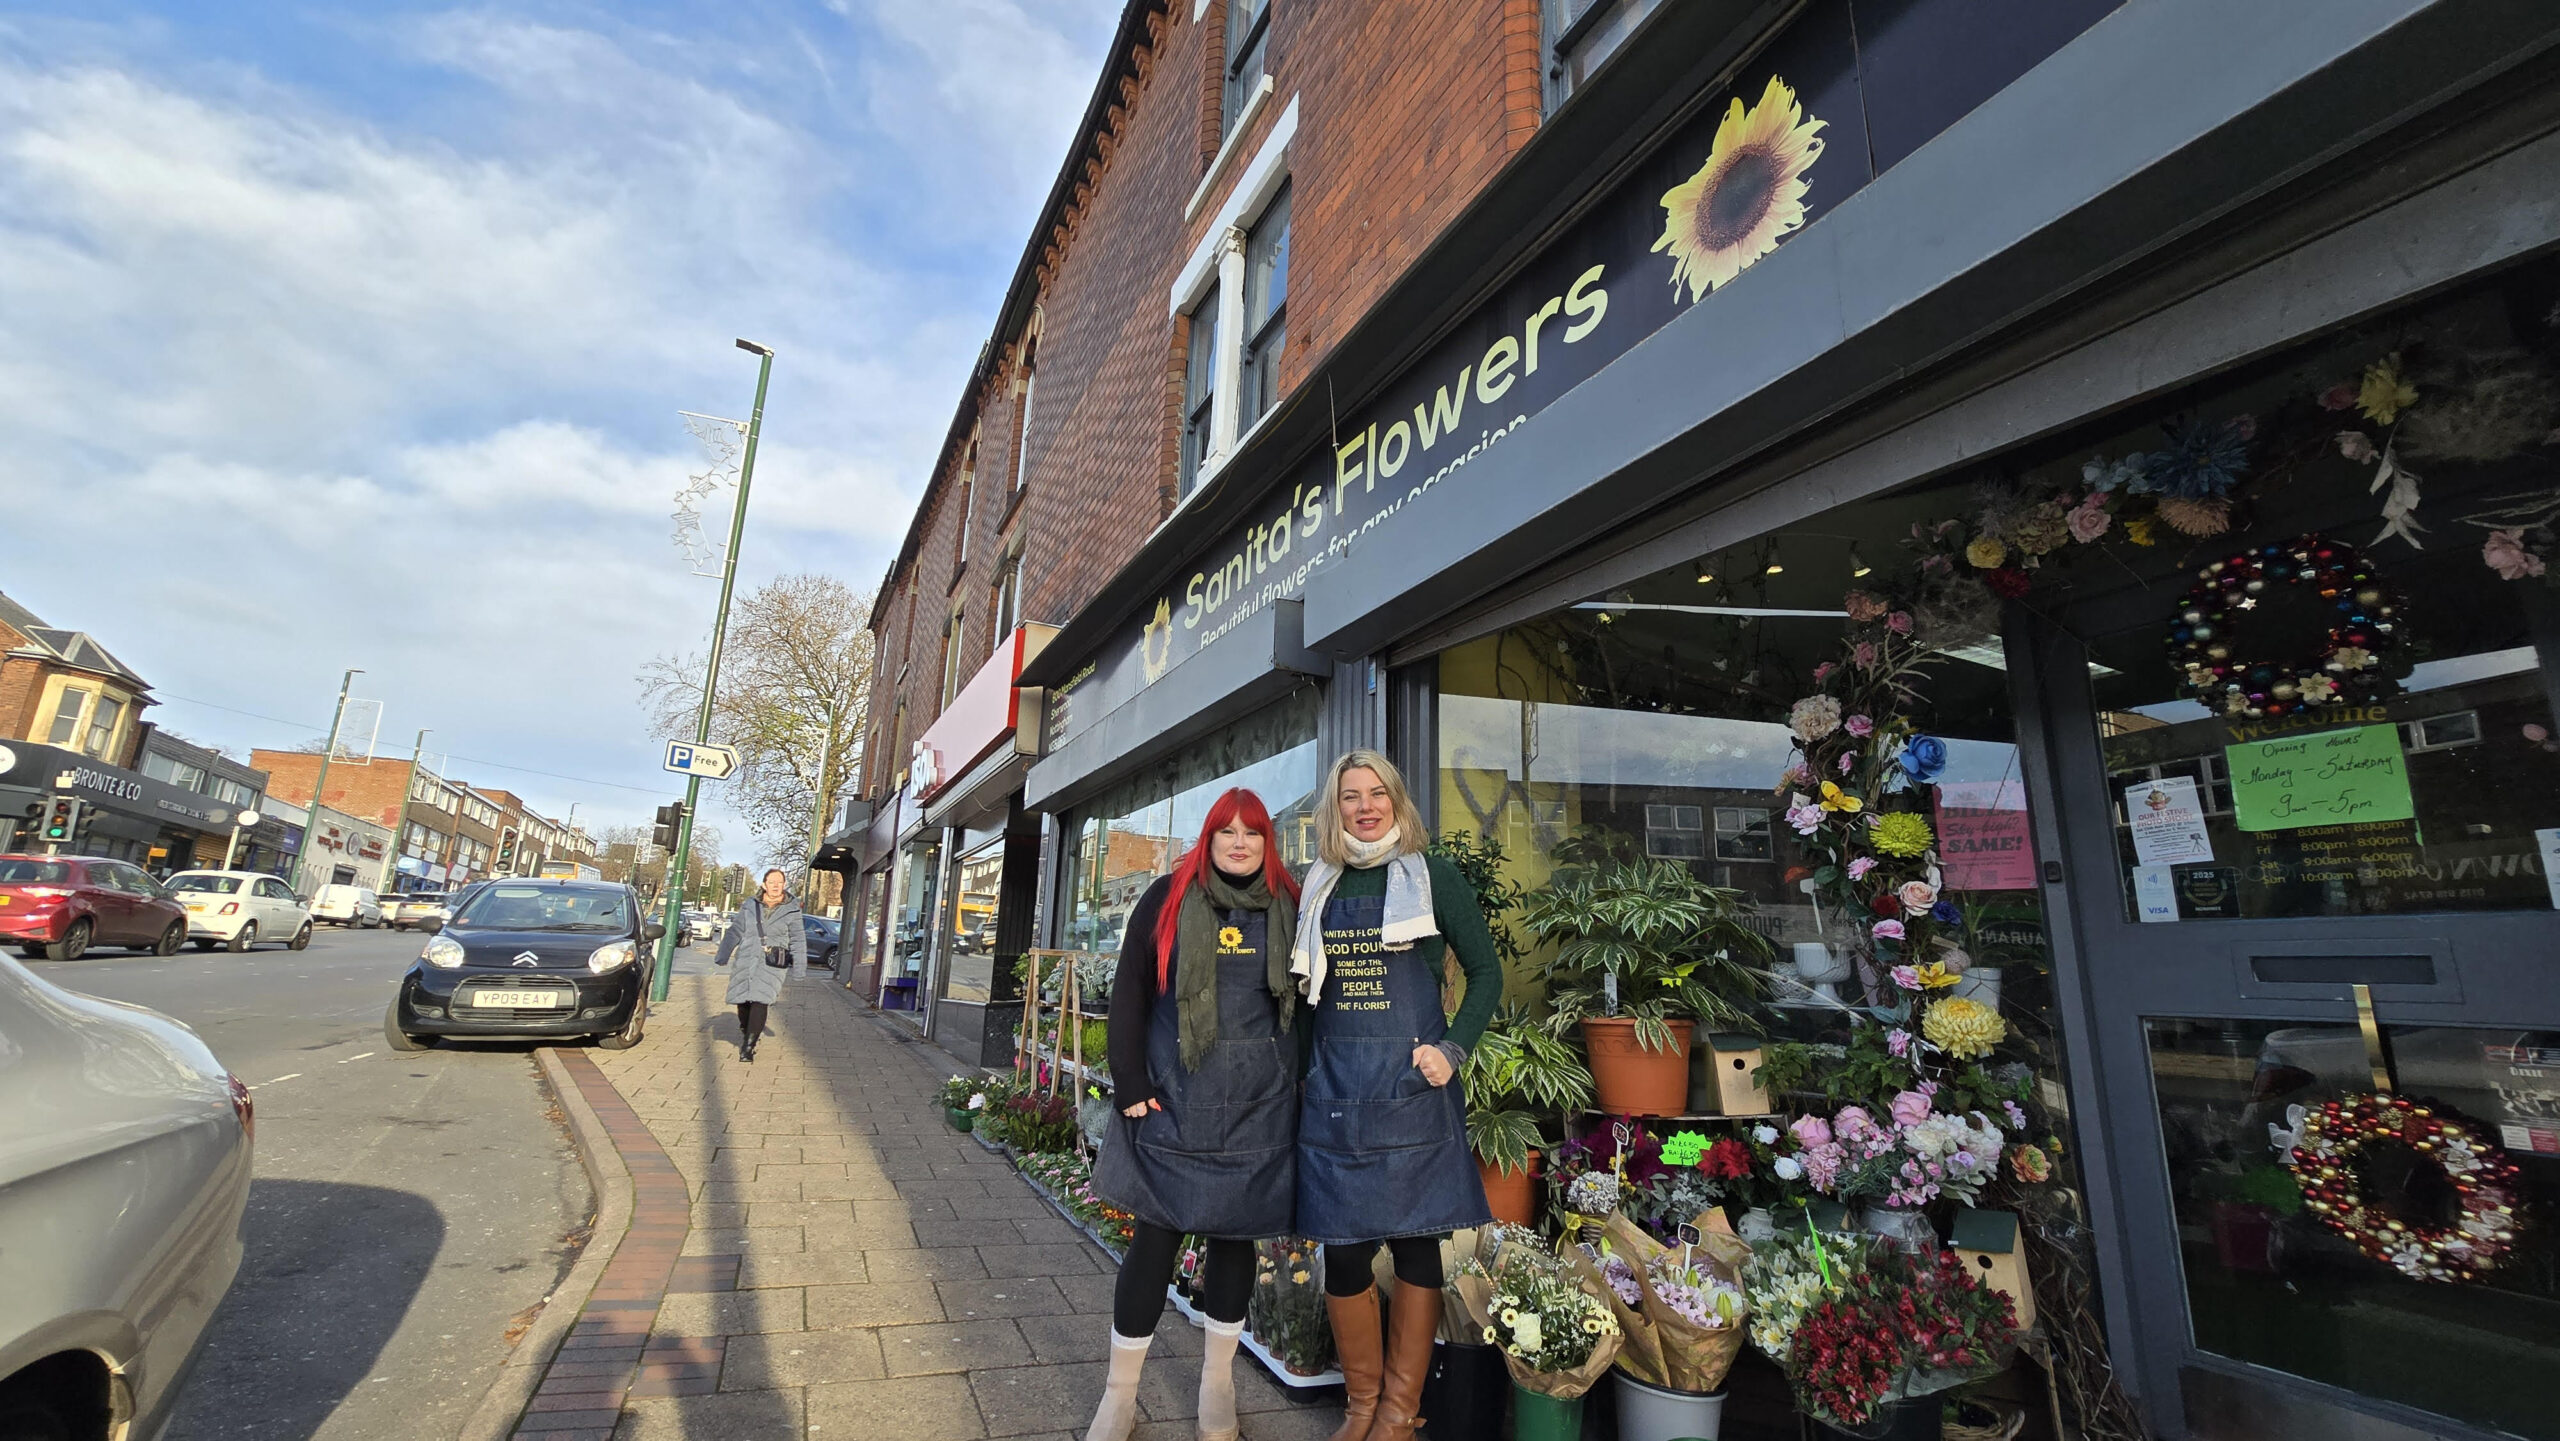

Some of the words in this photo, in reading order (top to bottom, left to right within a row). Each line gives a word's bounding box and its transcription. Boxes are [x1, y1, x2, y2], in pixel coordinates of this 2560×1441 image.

[1184, 483, 1322, 629] Sanita's
[1335, 264, 1608, 515] Flowers
[673, 747, 690, 766] P
[695, 755, 718, 767] Free
[74, 767, 117, 795] BRONTE
[116, 780, 125, 798] &
[126, 782, 142, 801] CO
[2240, 766, 2294, 788] Monday
[2253, 831, 2277, 841] Thu
[2297, 826, 2344, 837] 8:00am
[1946, 835, 2023, 854] SAME!
[2256, 846, 2272, 855] Fri
[2300, 841, 2348, 852] 8:00am
[2357, 836, 2409, 848] 8:00pm
[2259, 859, 2280, 869] Sat
[2303, 857, 2352, 867] 9:00am
[2360, 852, 2413, 864] 6:00pm
[2263, 875, 2286, 885] Sun
[2301, 872, 2355, 882] 10:00am
[1324, 929, 1355, 939] ANITA'S
[1356, 927, 1382, 937] FLOW
[1232, 946, 1257, 954] Flowers
[1325, 943, 1350, 955] GOD
[1353, 941, 1384, 954] FOUN
[1334, 966, 1388, 977] STRONGEST
[1342, 981, 1384, 991] PEOPLE
[482, 993, 519, 1005] YP09
[522, 993, 551, 1005] EAY
[1353, 1001, 1392, 1010] FLORIST
